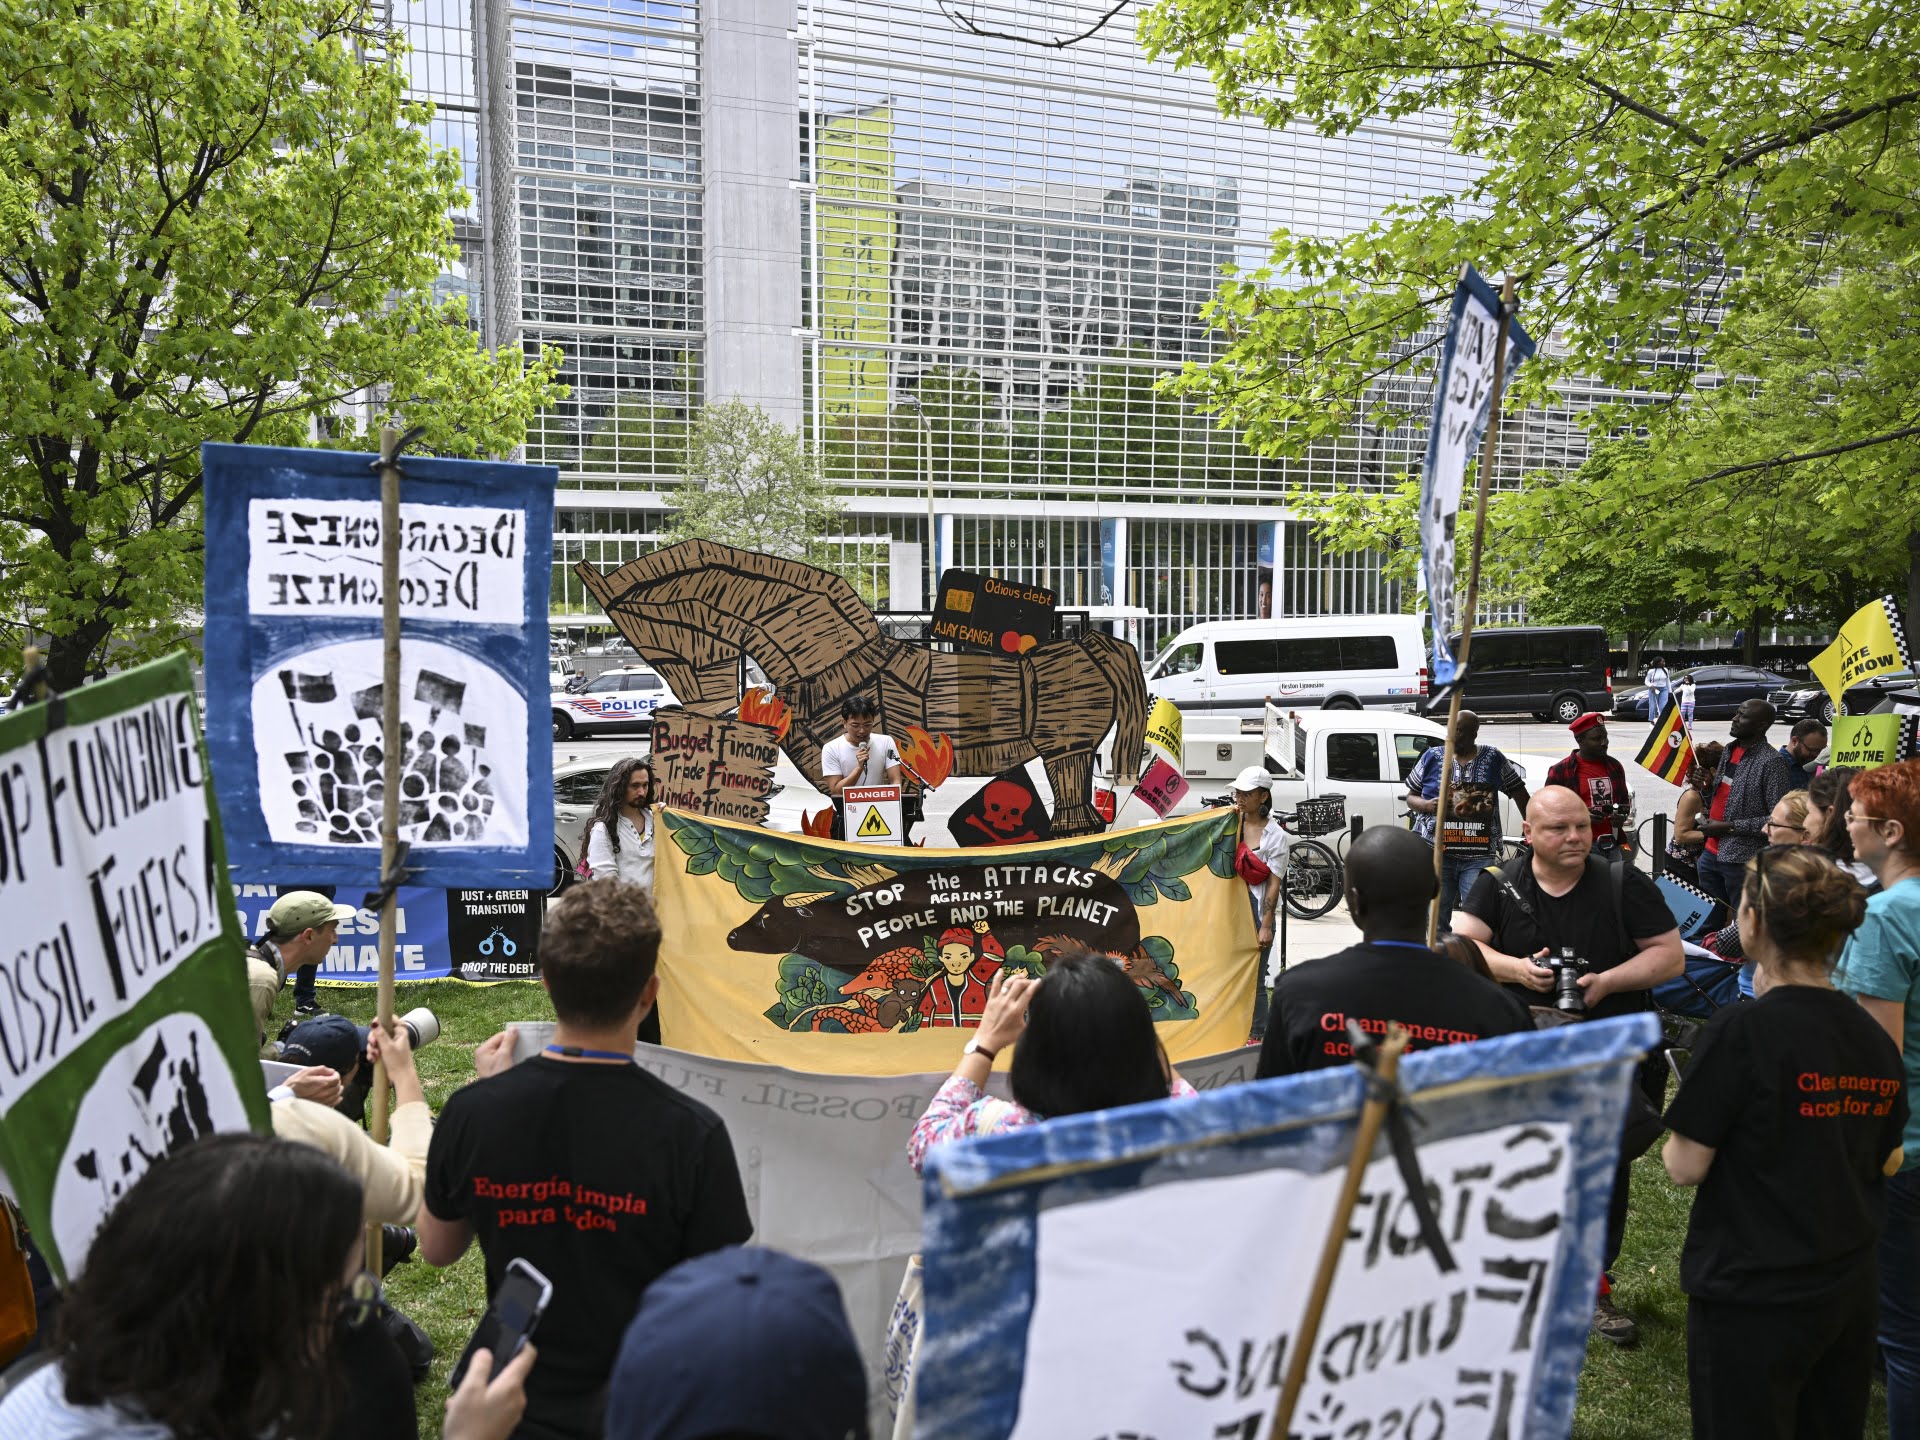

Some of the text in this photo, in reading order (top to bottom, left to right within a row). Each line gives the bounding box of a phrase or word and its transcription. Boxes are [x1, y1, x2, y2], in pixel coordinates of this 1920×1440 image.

[996, 538, 1045, 549] 1818
[985, 579, 1052, 606] Odious debt
[934, 620, 994, 647] AJAY BANGA
[1854, 653, 1895, 677] NOW
[602, 699, 658, 711] POLICE
[653, 721, 778, 763] Budget Finance
[1836, 751, 1885, 763] DROP THE
[36, 692, 205, 868] FUNDING
[664, 753, 769, 793] Trade Finance
[702, 788, 759, 818] Finance
[849, 790, 895, 799] DANGER
[1464, 822, 1485, 831] BANK:
[461, 891, 484, 901] JUST
[495, 890, 529, 900] GREEN
[846, 866, 1097, 916] STOP the ATTACKS
[930, 890, 1004, 905] AGAINST
[465, 904, 525, 915] TRANSITION
[857, 896, 1119, 949] PEOPLE AND THE PLANET
[461, 962, 535, 973] DROP THE DEBT
[0, 921, 95, 1077] OSSIL
[1838, 1075, 1900, 1096] energy
[1842, 1096, 1871, 1115] for
[472, 1175, 571, 1201] Energía
[498, 1204, 617, 1232] para tdos
